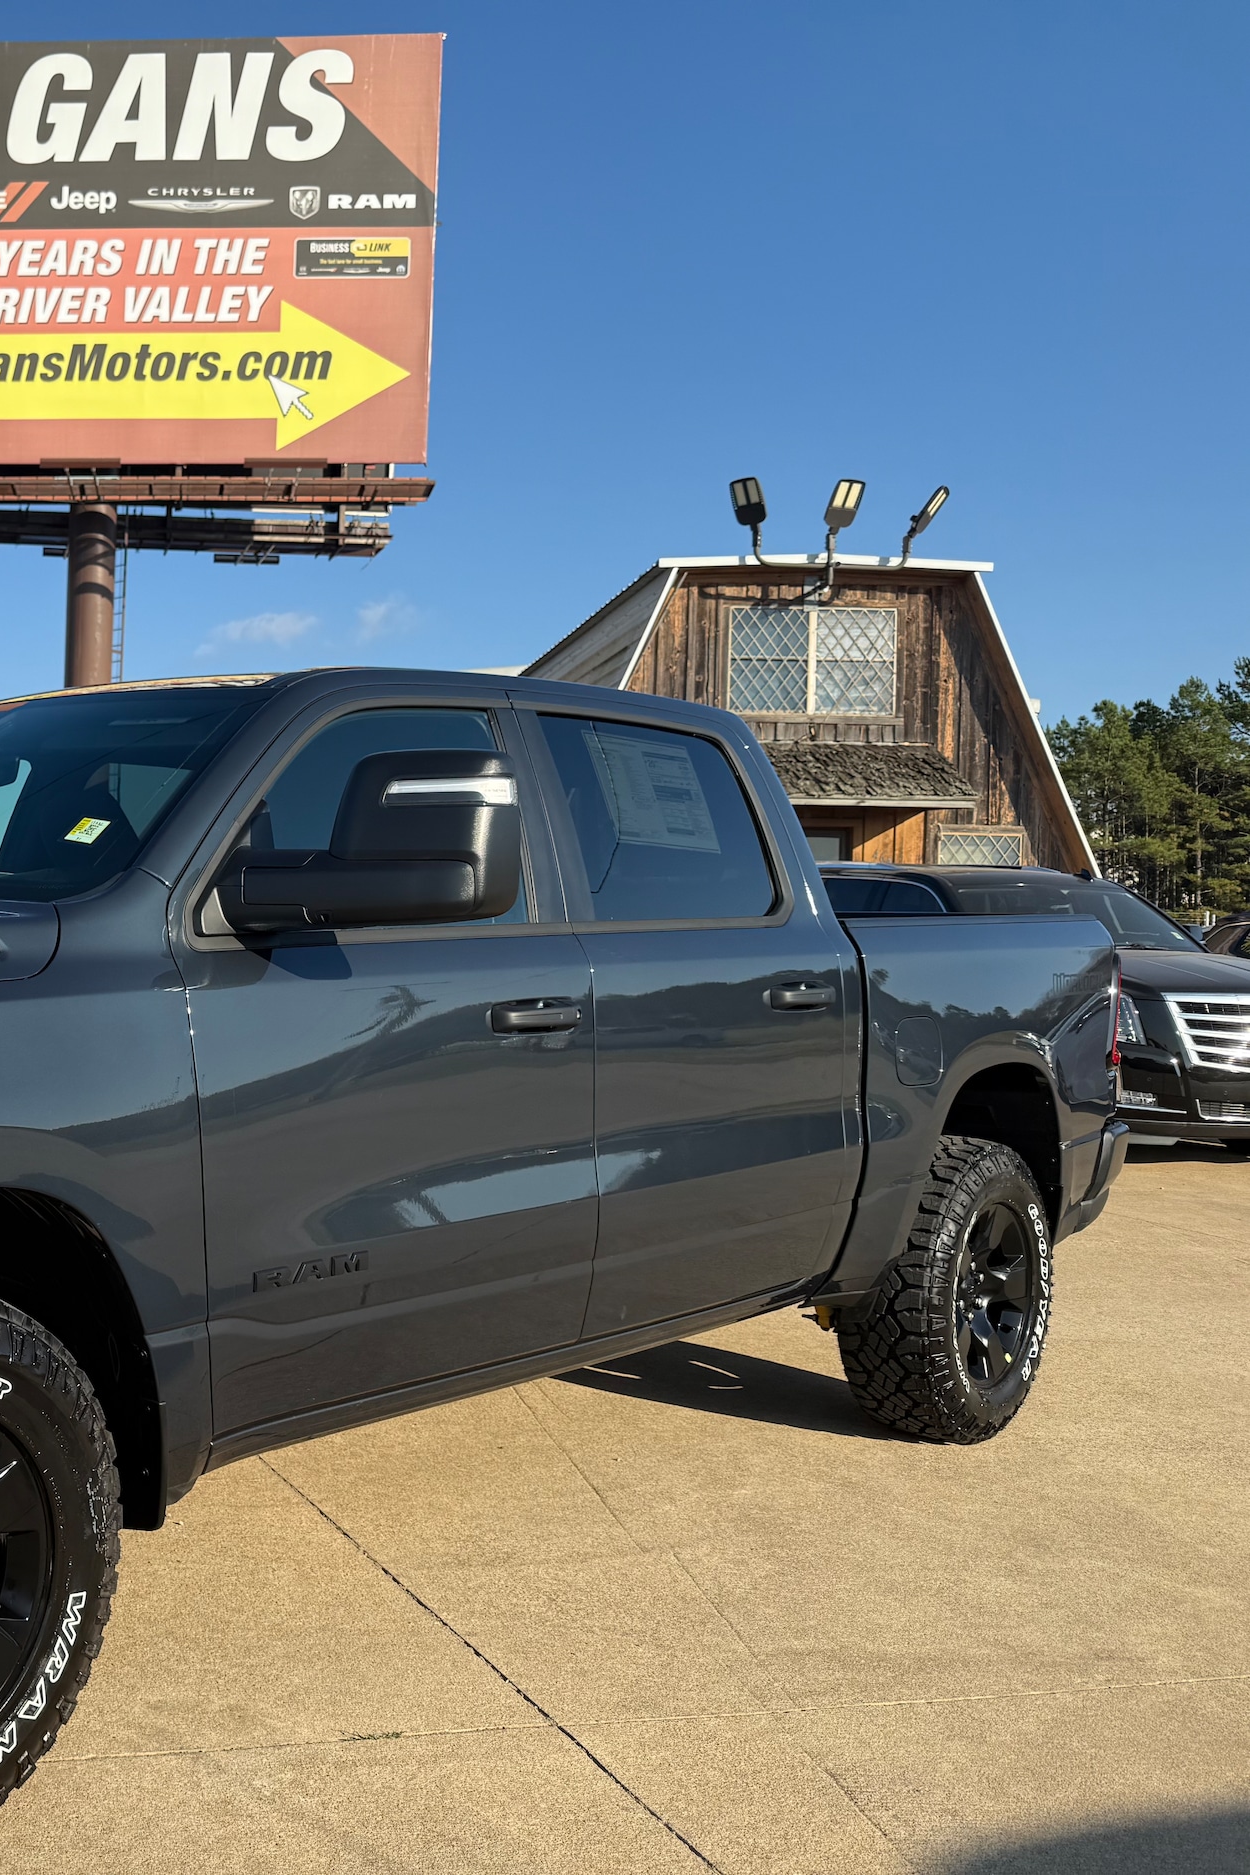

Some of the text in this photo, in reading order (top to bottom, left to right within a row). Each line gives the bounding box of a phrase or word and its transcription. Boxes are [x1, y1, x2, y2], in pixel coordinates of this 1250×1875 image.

[49, 184, 117, 214] Jeep
[147, 187, 255, 197] CHRYSLER
[327, 193, 417, 210] RAM
[134, 239, 182, 276] IN
[192, 238, 271, 275] THE
[369, 243, 392, 252] LINK
[123, 286, 275, 323] VALLEY
[251, 1250, 369, 1293] RAM
[1021, 1203, 1050, 1381] GOODYEAR
